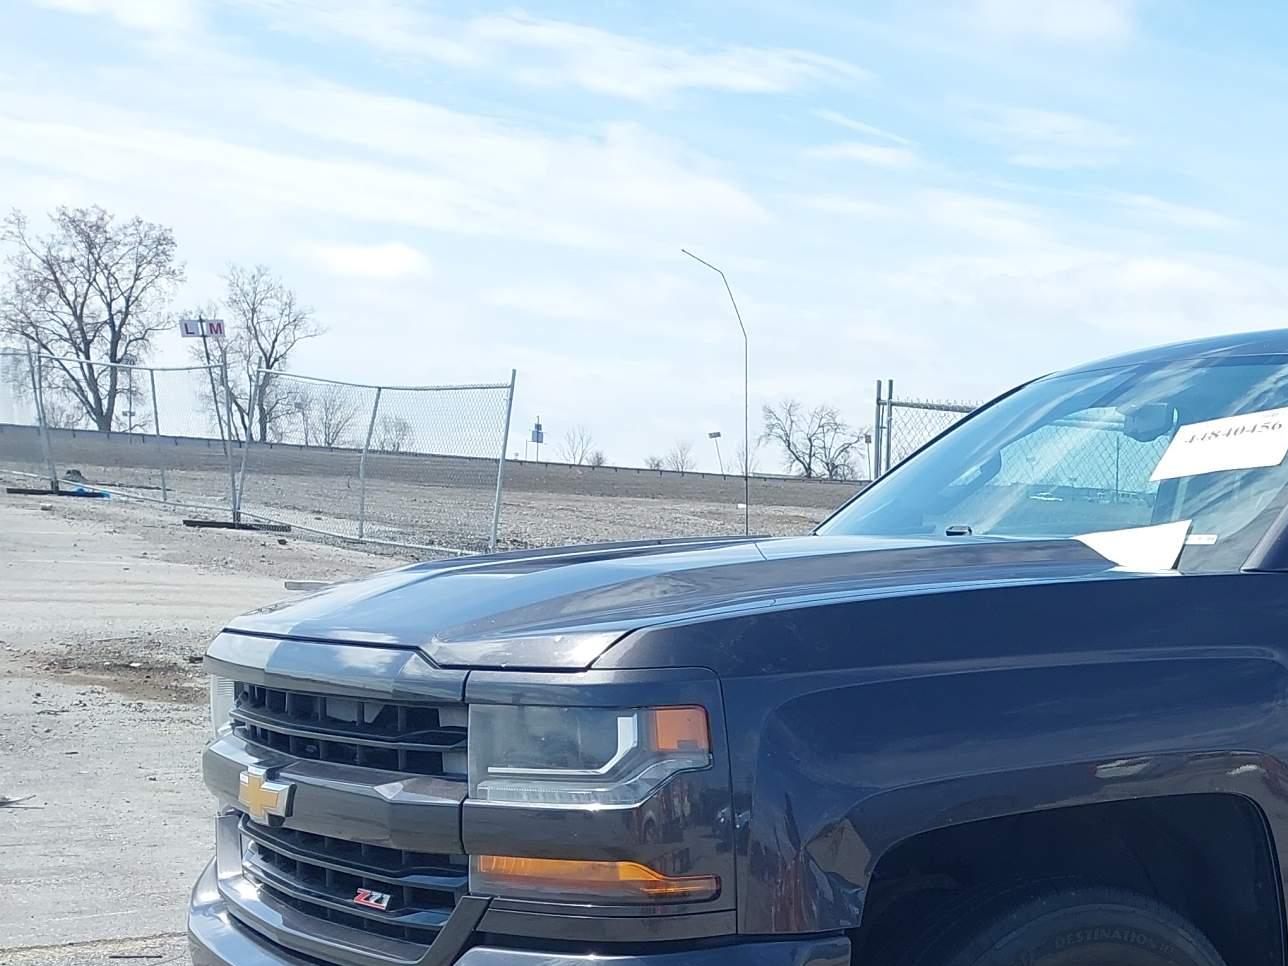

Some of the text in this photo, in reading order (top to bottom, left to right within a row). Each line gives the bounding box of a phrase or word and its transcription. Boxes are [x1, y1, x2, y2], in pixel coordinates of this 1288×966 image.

[184, 323, 195, 335] L
[209, 323, 223, 335] M
[353, 888, 391, 910] Z71
